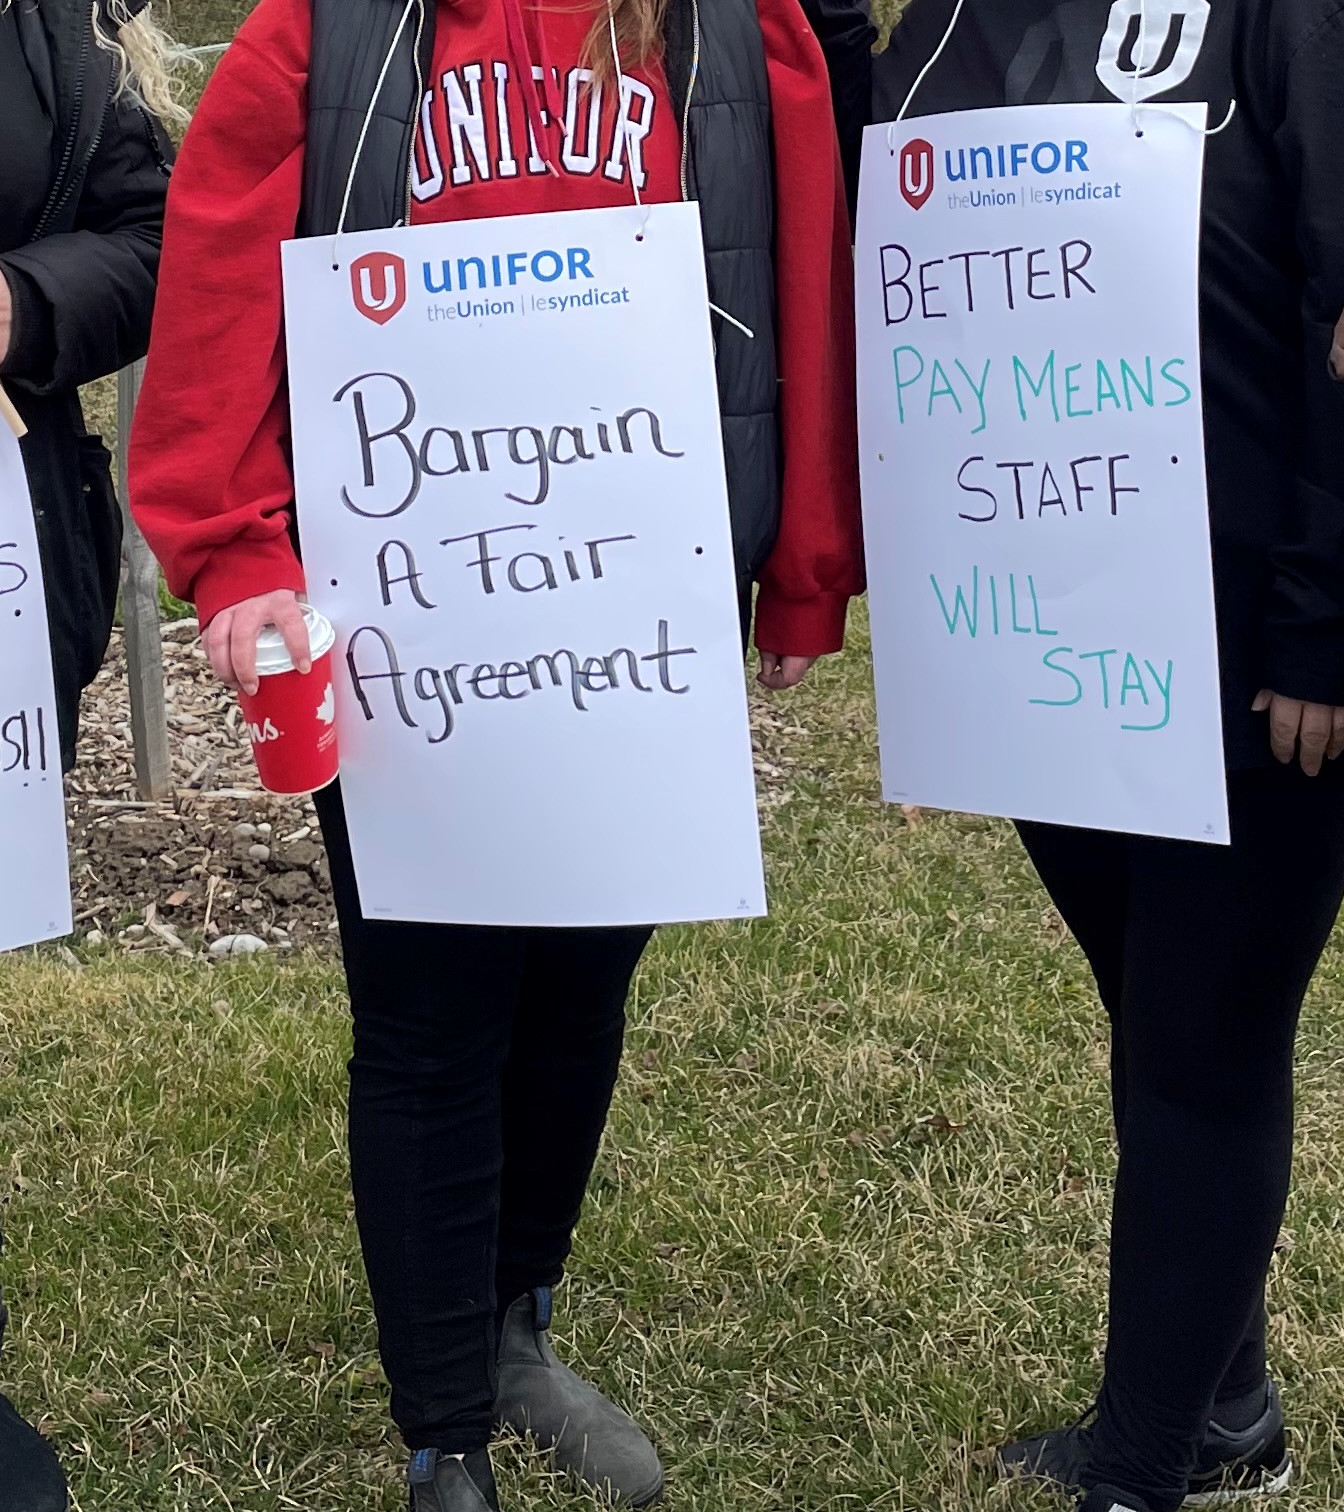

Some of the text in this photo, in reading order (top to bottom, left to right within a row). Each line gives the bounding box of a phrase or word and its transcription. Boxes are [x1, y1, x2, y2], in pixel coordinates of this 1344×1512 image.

[948, 182, 1122, 210] theUnion lesyndicat
[427, 287, 630, 322] theUnion lesyndicat
[878, 238, 1096, 327] BETTER
[893, 345, 1193, 434] PAY MEANS
[332, 371, 686, 519] Bargain
[956, 454, 1140, 522] STAFF
[377, 523, 637, 610] A Fair
[928, 565, 1059, 639] WILL
[344, 618, 698, 746] Agreement
[1028, 648, 1175, 731] STAY
